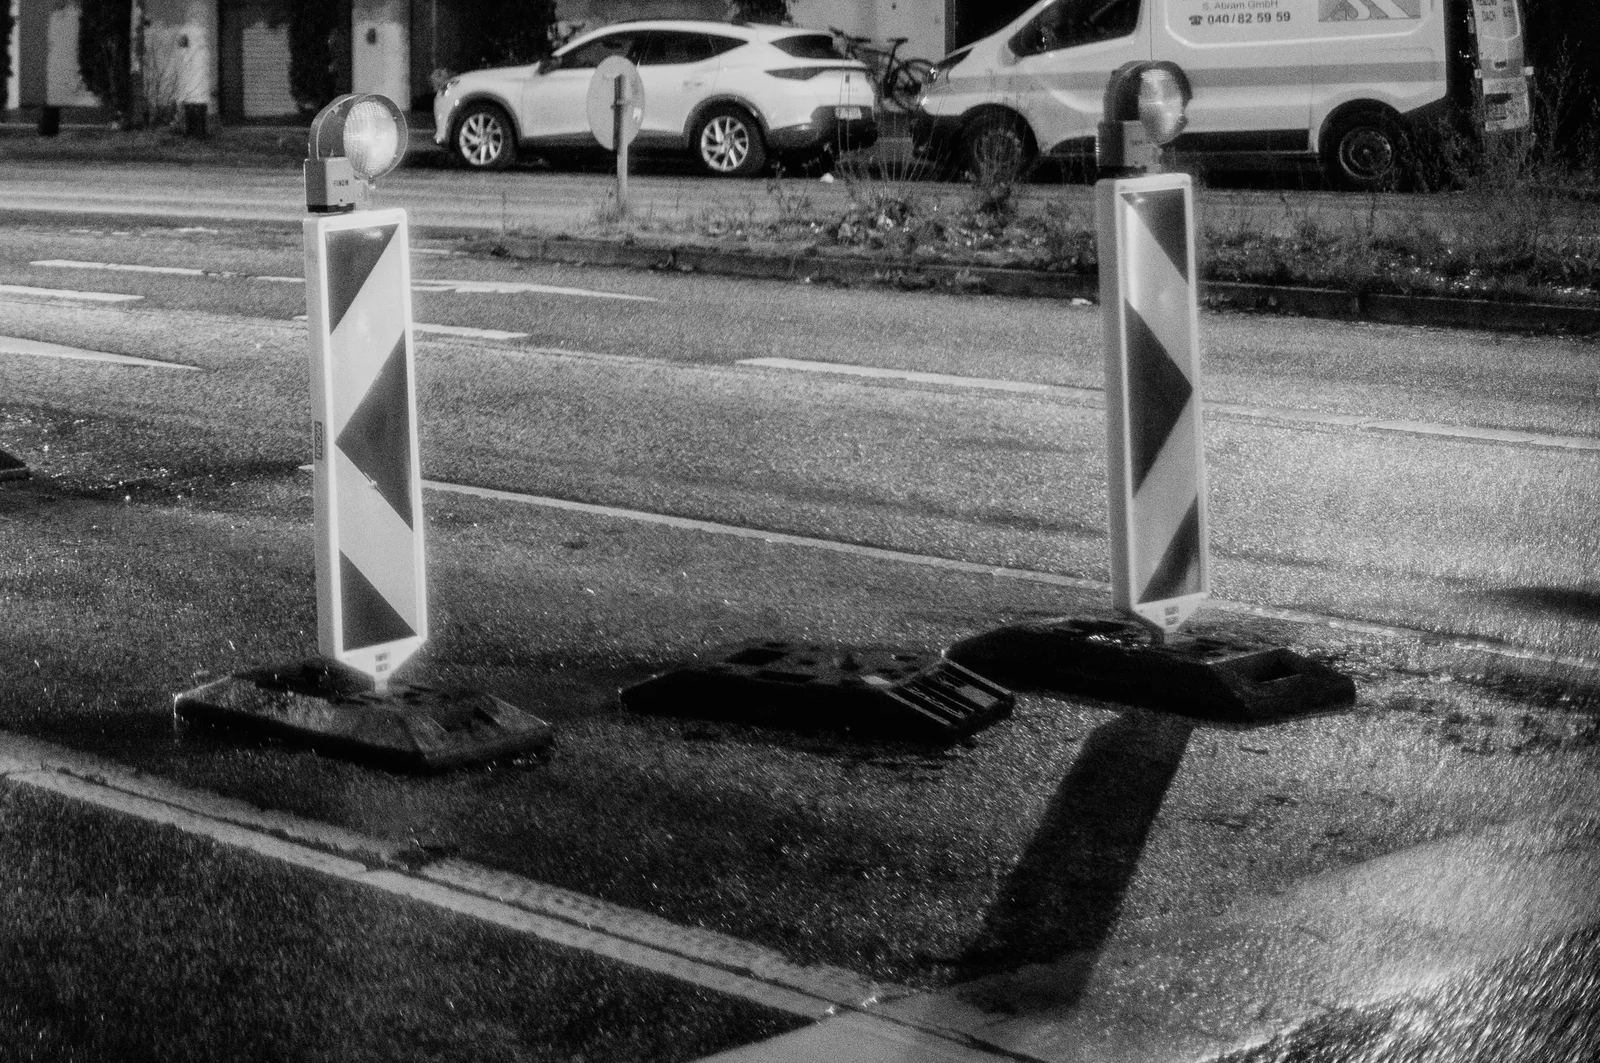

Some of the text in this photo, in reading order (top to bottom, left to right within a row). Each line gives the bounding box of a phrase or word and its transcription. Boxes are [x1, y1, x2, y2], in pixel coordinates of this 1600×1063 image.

[1247, 0, 1279, 9] GmbH
[1256, 11, 1272, 24] 59
[1276, 11, 1291, 23] 59
